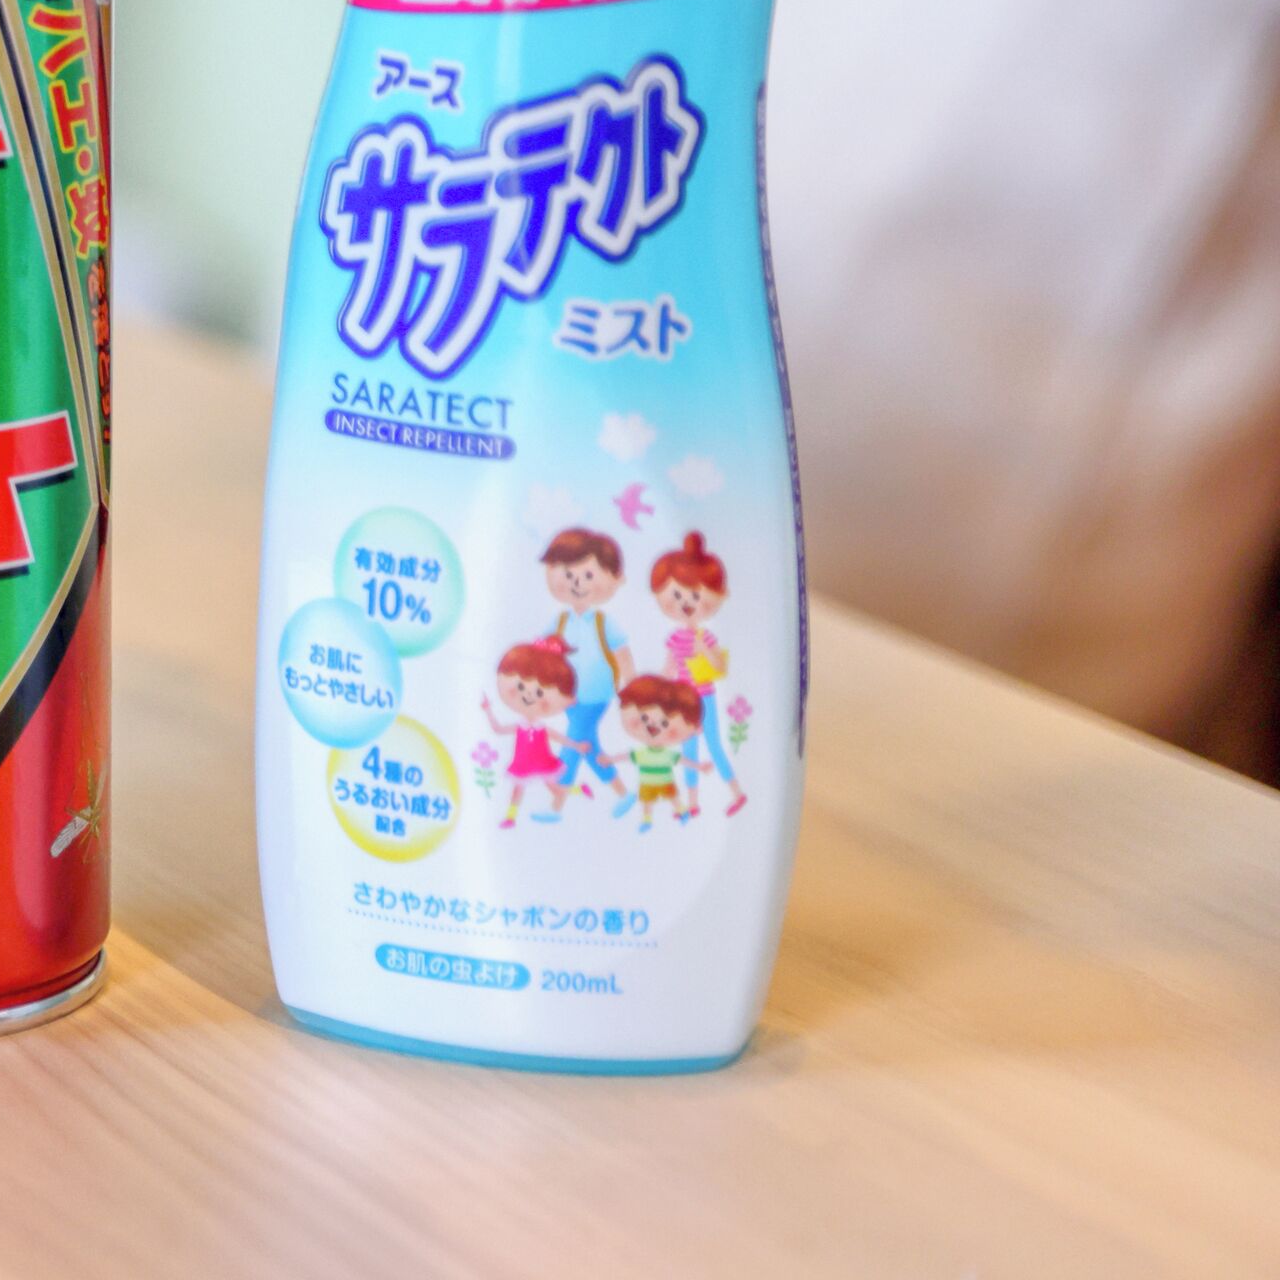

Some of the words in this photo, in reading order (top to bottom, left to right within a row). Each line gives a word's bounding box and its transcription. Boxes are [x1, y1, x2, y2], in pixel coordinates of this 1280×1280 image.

[375, 55, 463, 108] アース
[337, 81, 687, 357] サラテクト
[558, 302, 687, 355] ミスト
[331, 373, 514, 429] SARATECT
[333, 413, 401, 444] INSECT
[402, 426, 504, 457] REPELLENT
[354, 548, 442, 582] 有効成分
[361, 581, 431, 624] 10%
[308, 644, 363, 673] お肌に
[284, 667, 394, 709] もっとやさしい
[334, 778, 452, 820] うるおい成分
[353, 882, 650, 935] さわやかなシャボンの香り
[385, 948, 521, 989] お肌の虫よけ
[541, 970, 623, 995] 200mL
